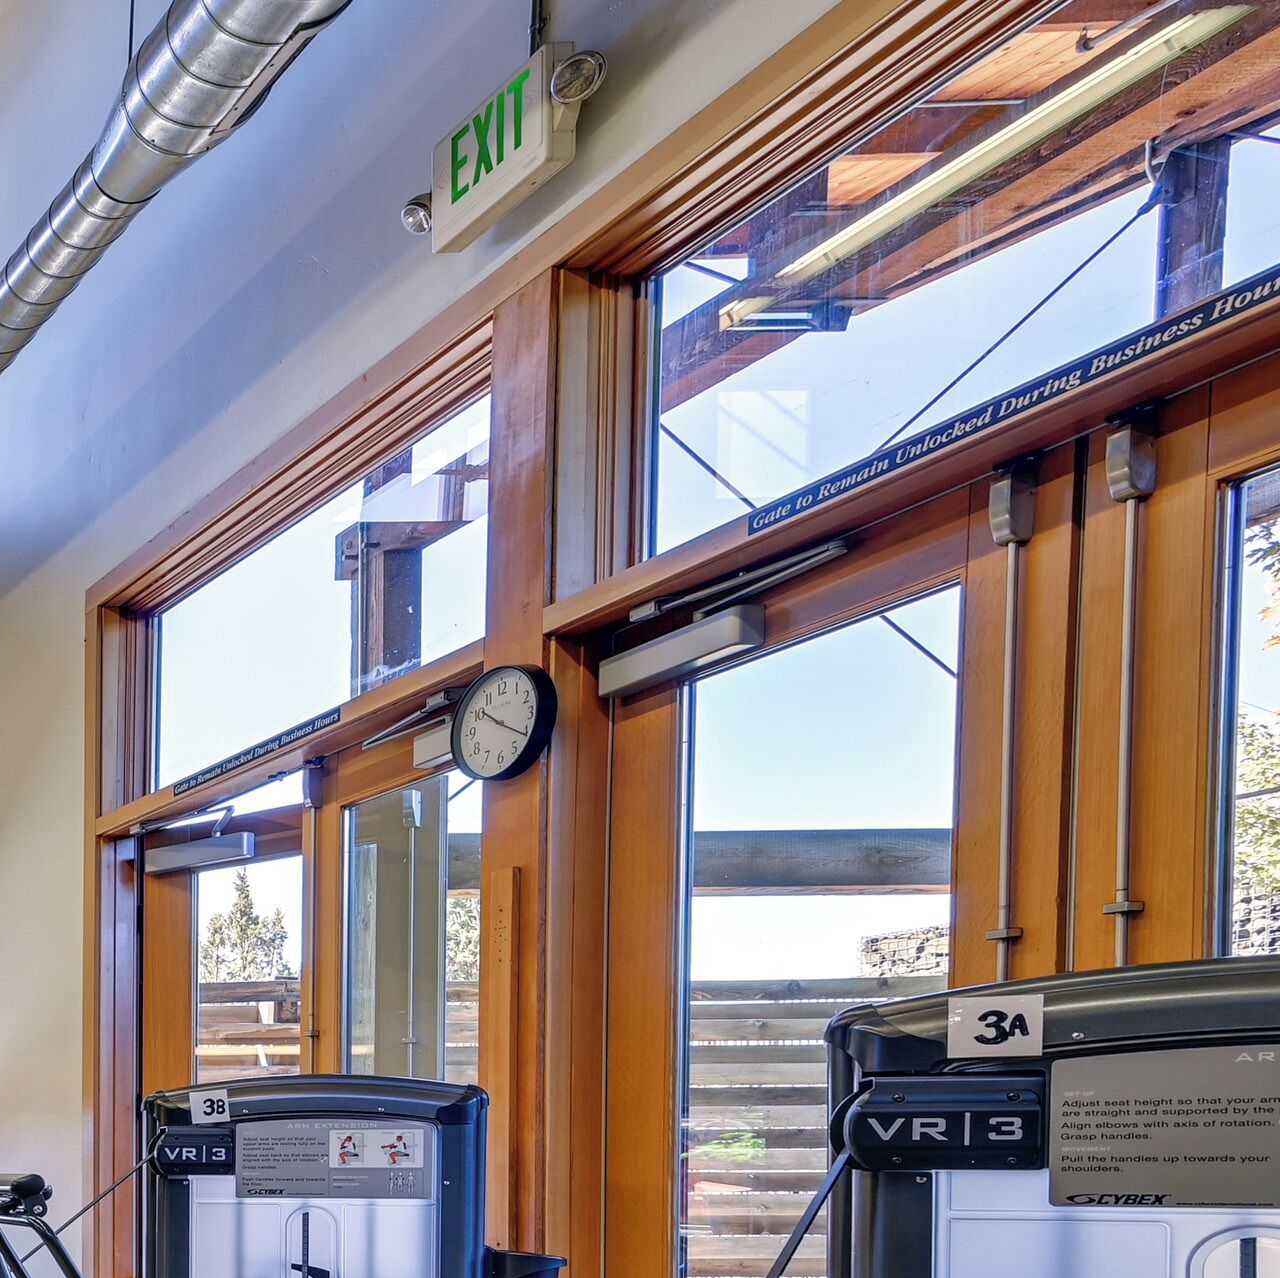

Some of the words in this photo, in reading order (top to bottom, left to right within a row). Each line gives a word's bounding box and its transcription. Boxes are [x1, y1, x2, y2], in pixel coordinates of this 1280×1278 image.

[451, 67, 530, 205] EXIT
[753, 505, 791, 529] Gate
[795, 494, 813, 511] to
[817, 460, 890, 501] Remain
[895, 407, 993, 463] Unlocked
[997, 369, 1082, 418] During
[1088, 313, 1203, 377] Business
[498, 681, 507, 696] 12
[515, 682, 519, 695] 1
[485, 693, 492, 706] 11
[523, 690, 530, 704] 2
[474, 707, 485, 722] 10
[527, 706, 534, 720] 3
[469, 727, 476, 739] 9
[522, 724, 529, 737] 4
[473, 742, 480, 755] 8
[511, 741, 518, 755] 5
[484, 750, 490, 764] 7
[498, 751, 504, 764] 6
[973, 1010, 1029, 1045] 3A
[203, 1098, 226, 1116] 3B
[1062, 1100, 1100, 1109] Adjust
[1104, 1099, 1130, 1107] seat
[1134, 1098, 1172, 1107] height
[1197, 1097, 1222, 1105] that
[1226, 1097, 1256, 1106] your
[1084, 1109, 1130, 1118] straight
[1134, 1108, 1158, 1116] and
[1162, 1107, 1228, 1116] supported
[1233, 1106, 1249, 1115] by
[1253, 1106, 1275, 1114] the
[1061, 1121, 1091, 1130] Align
[1095, 1121, 1139, 1129] elbows
[1143, 1120, 1169, 1128] with
[1173, 1120, 1199, 1128] axis
[1203, 1119, 1216, 1127] of
[1220, 1119, 1275, 1127] rotation.
[1060, 1132, 1097, 1141] Grasp
[1101, 1132, 1152, 1140] handles.
[1061, 1155, 1083, 1163] Pull
[1088, 1155, 1107, 1163] the
[1110, 1155, 1159, 1163] handles
[1163, 1156, 1180, 1164] up
[1240, 1155, 1270, 1164] your
[1060, 1165, 1124, 1173] shoulders.
[1096, 1193, 1169, 1205] CYBEX
